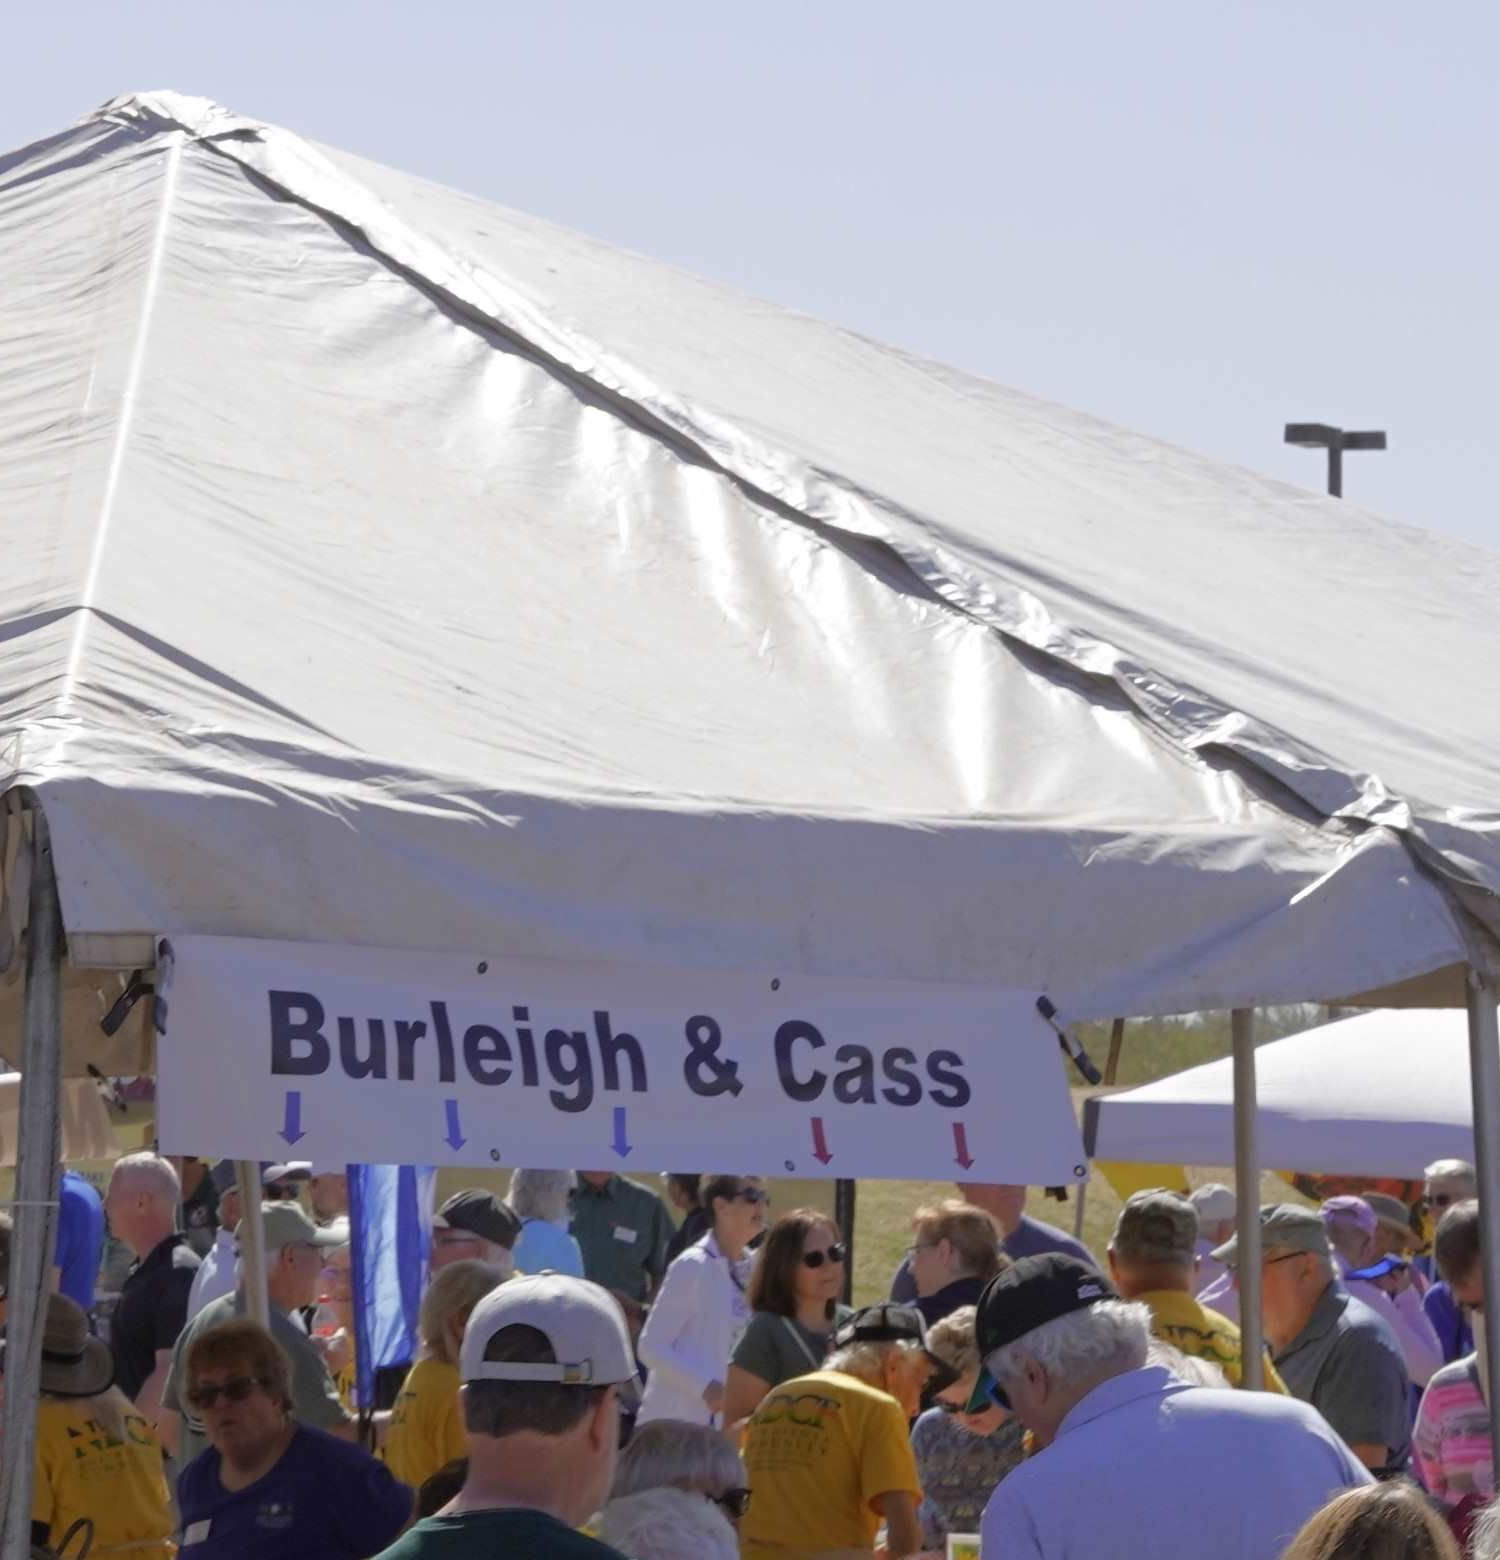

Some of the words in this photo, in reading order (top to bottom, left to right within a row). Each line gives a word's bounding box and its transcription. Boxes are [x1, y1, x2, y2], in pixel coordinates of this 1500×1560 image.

[268, 990, 647, 1113] Burleigh
[684, 1015, 744, 1097] &
[773, 1020, 971, 1108] Cass
